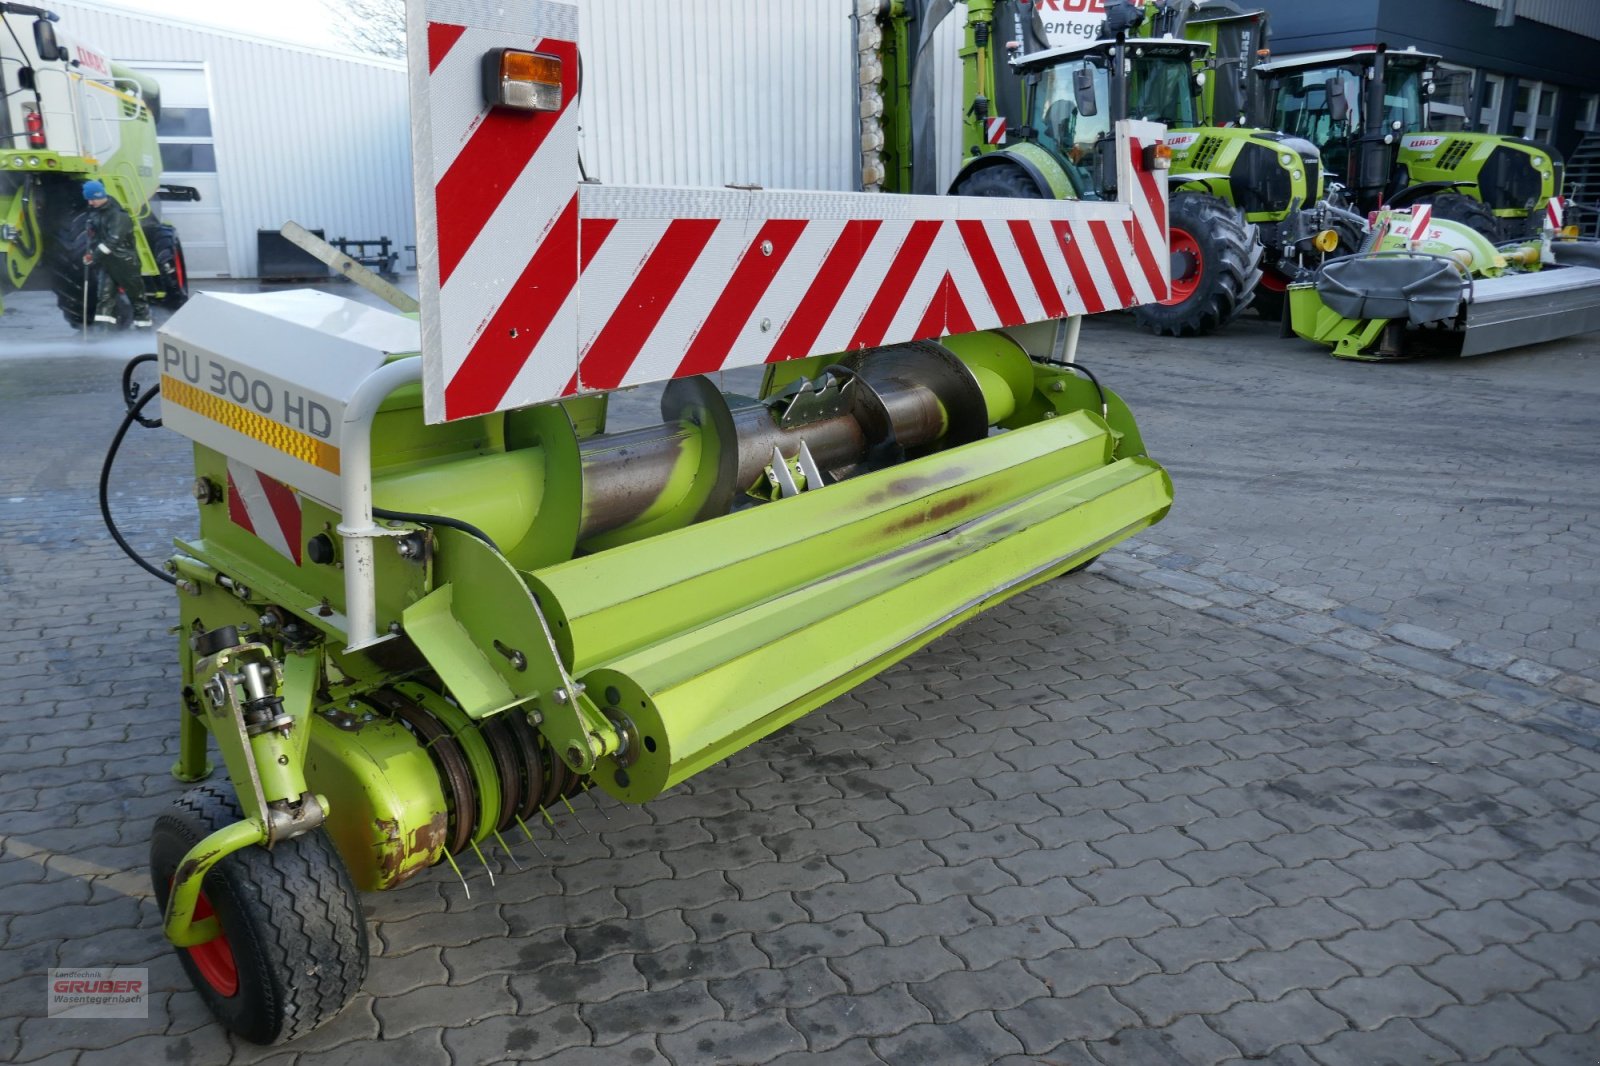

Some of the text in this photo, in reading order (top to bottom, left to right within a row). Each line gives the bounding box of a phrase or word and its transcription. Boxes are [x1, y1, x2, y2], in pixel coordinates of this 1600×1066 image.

[1044, 20, 1103, 39] entege
[1410, 139, 1441, 148] CLAAS
[1394, 225, 1443, 239] CLS
[162, 342, 332, 439] PU 300 HD
